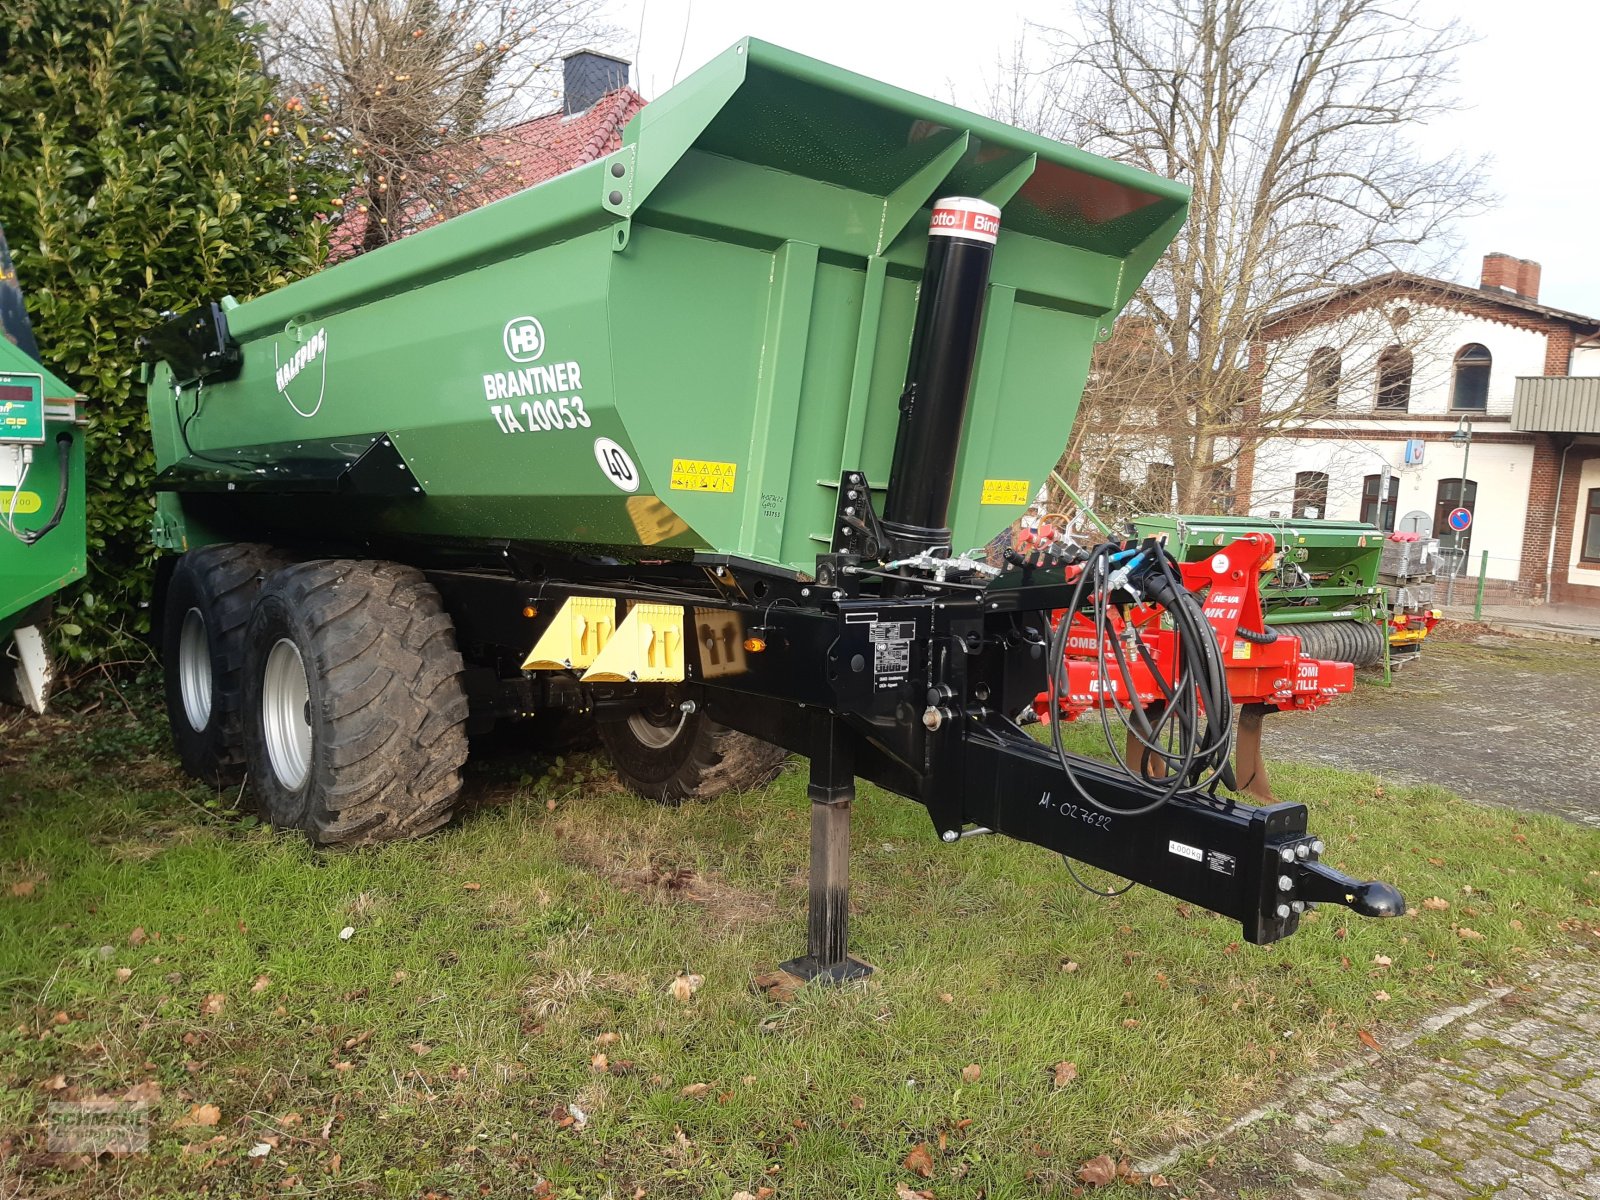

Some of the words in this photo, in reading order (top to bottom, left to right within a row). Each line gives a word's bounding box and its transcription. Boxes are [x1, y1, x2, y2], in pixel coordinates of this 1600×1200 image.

[483, 361, 583, 400] BRANTNER
[491, 404, 525, 434] TA
[520, 396, 592, 431] 20053
[602, 448, 633, 481] 40
[1214, 595, 1239, 603] HE-VA
[1204, 607, 1226, 618] MK
[1170, 843, 1191, 855] 4.000
[1191, 848, 1201, 860] kg
